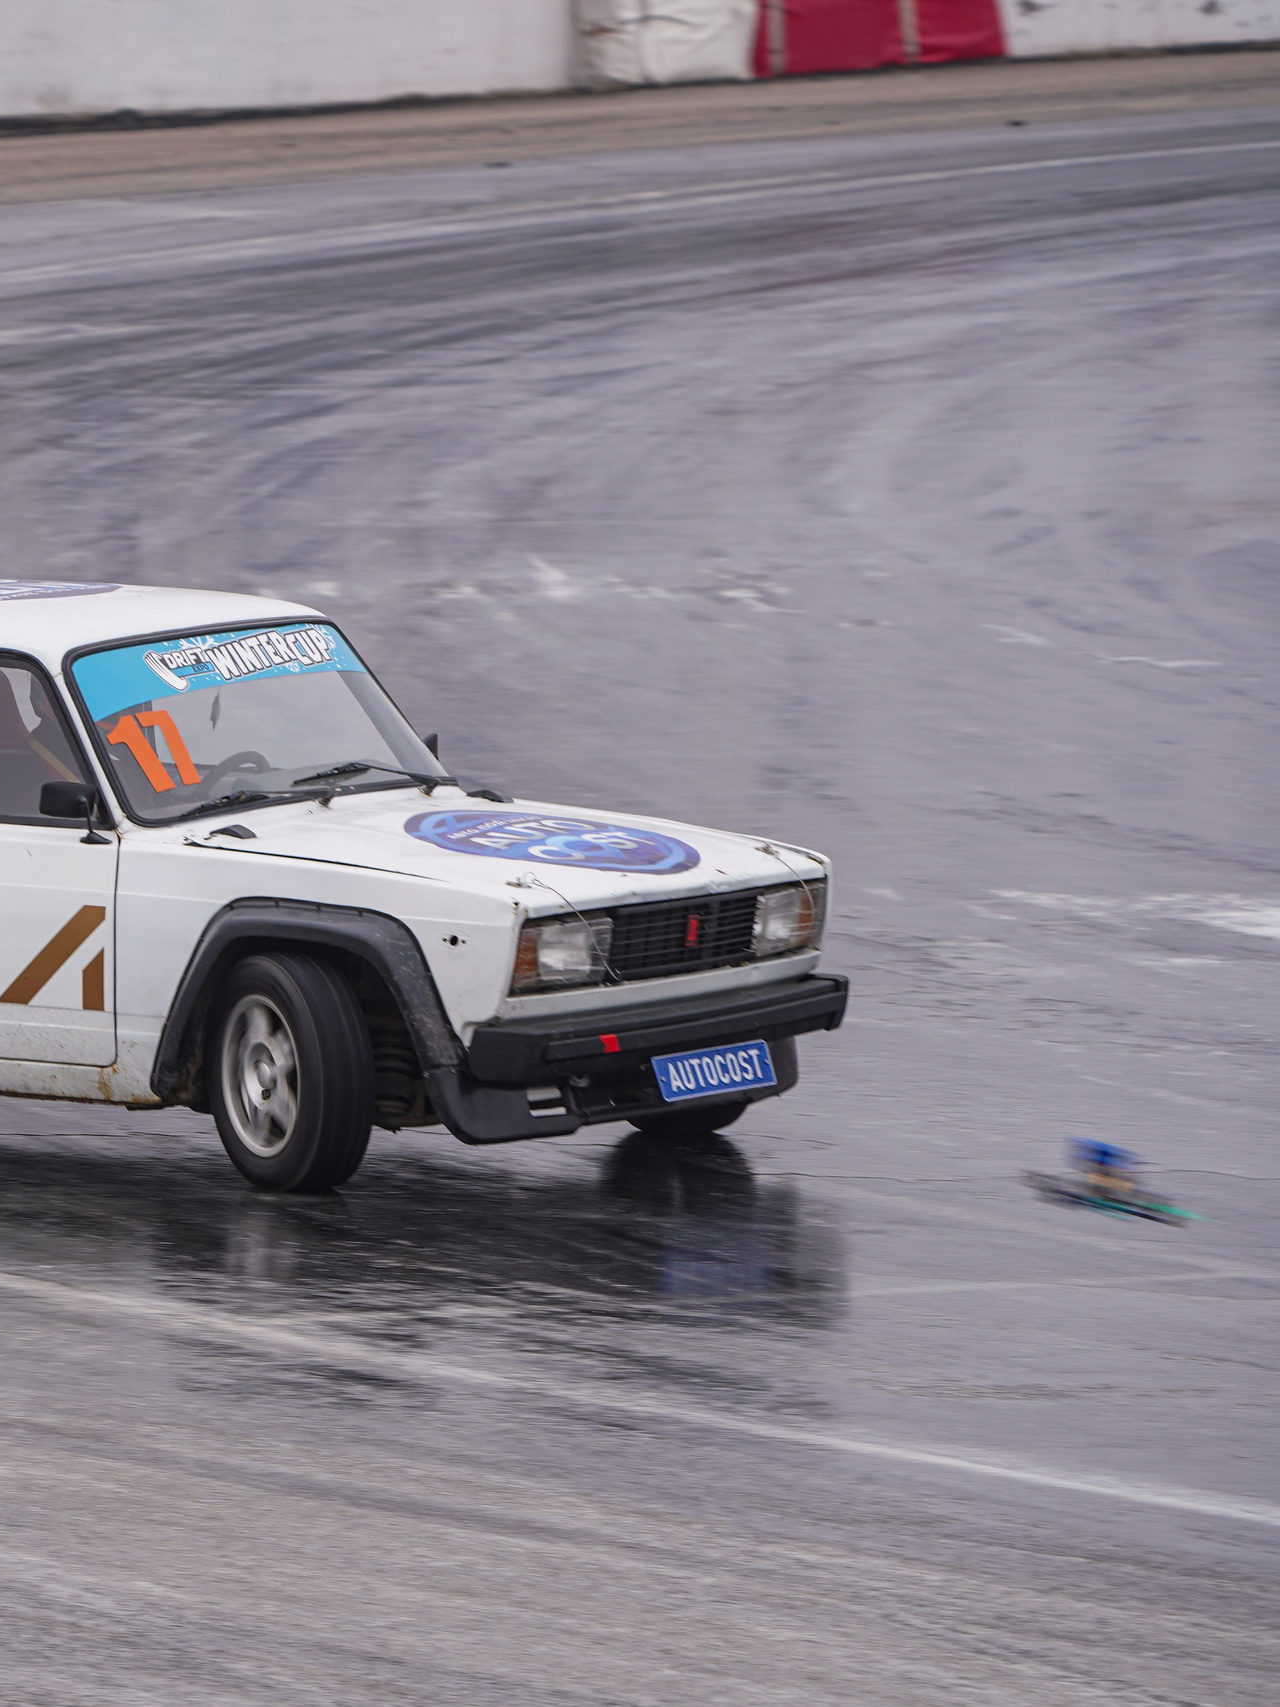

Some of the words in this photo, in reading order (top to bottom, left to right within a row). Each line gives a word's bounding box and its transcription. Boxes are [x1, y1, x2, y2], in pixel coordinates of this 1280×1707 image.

[165, 648, 207, 669] DRIFT
[106, 710, 202, 793] 17
[470, 819, 597, 849] AUTO
[667, 1049, 763, 1092] AUTOCOST
